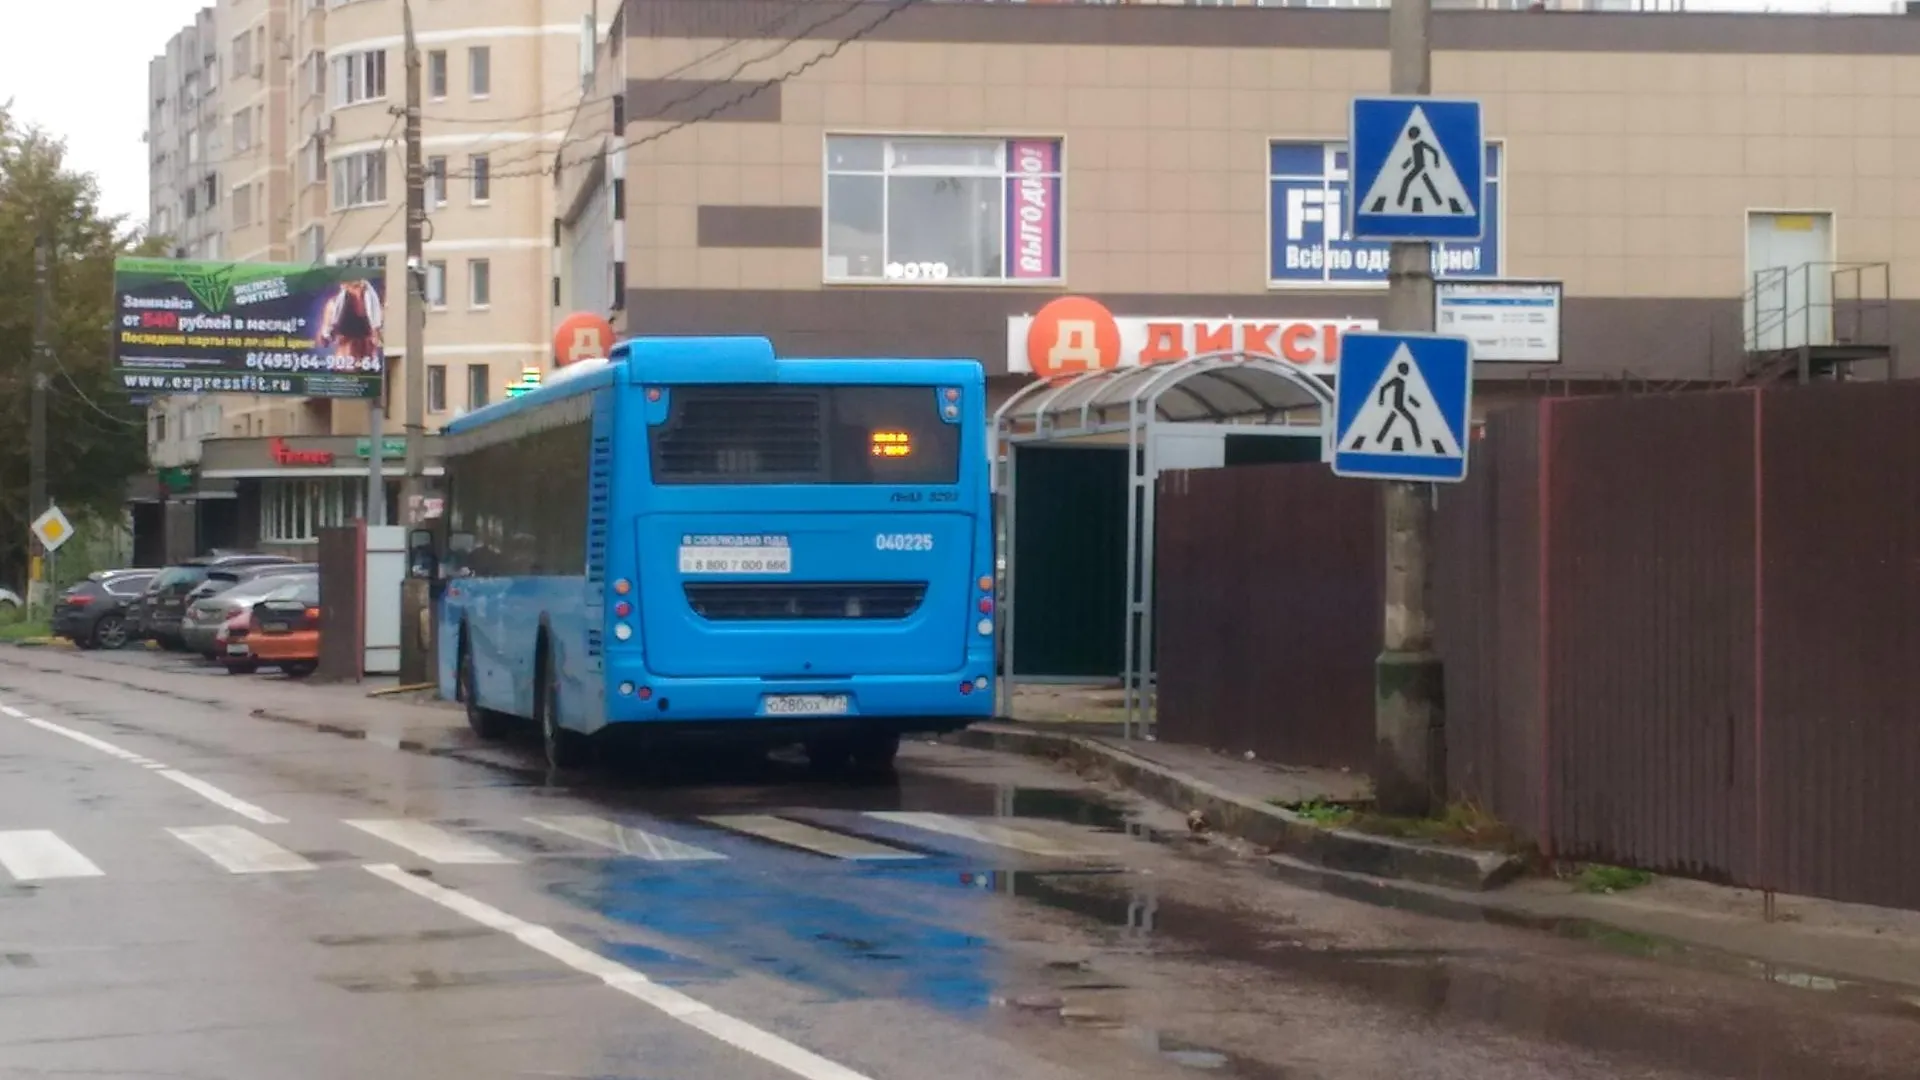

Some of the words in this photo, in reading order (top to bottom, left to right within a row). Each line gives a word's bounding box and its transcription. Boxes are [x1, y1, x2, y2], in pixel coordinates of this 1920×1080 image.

[1020, 147, 1045, 272] ВЫГОДНО!
[1287, 189, 1350, 240] Fi
[1286, 243, 1323, 269] Всё
[1327, 249, 1352, 269] по
[886, 262, 948, 279] ФОТО
[123, 295, 193, 309] Занимайся
[123, 315, 140, 326] от
[178, 314, 232, 332] рублей
[234, 319, 244, 330] в
[1048, 319, 1101, 369] Д
[125, 374, 291, 391] www.expressfit.ru
[876, 534, 933, 550] 040225
